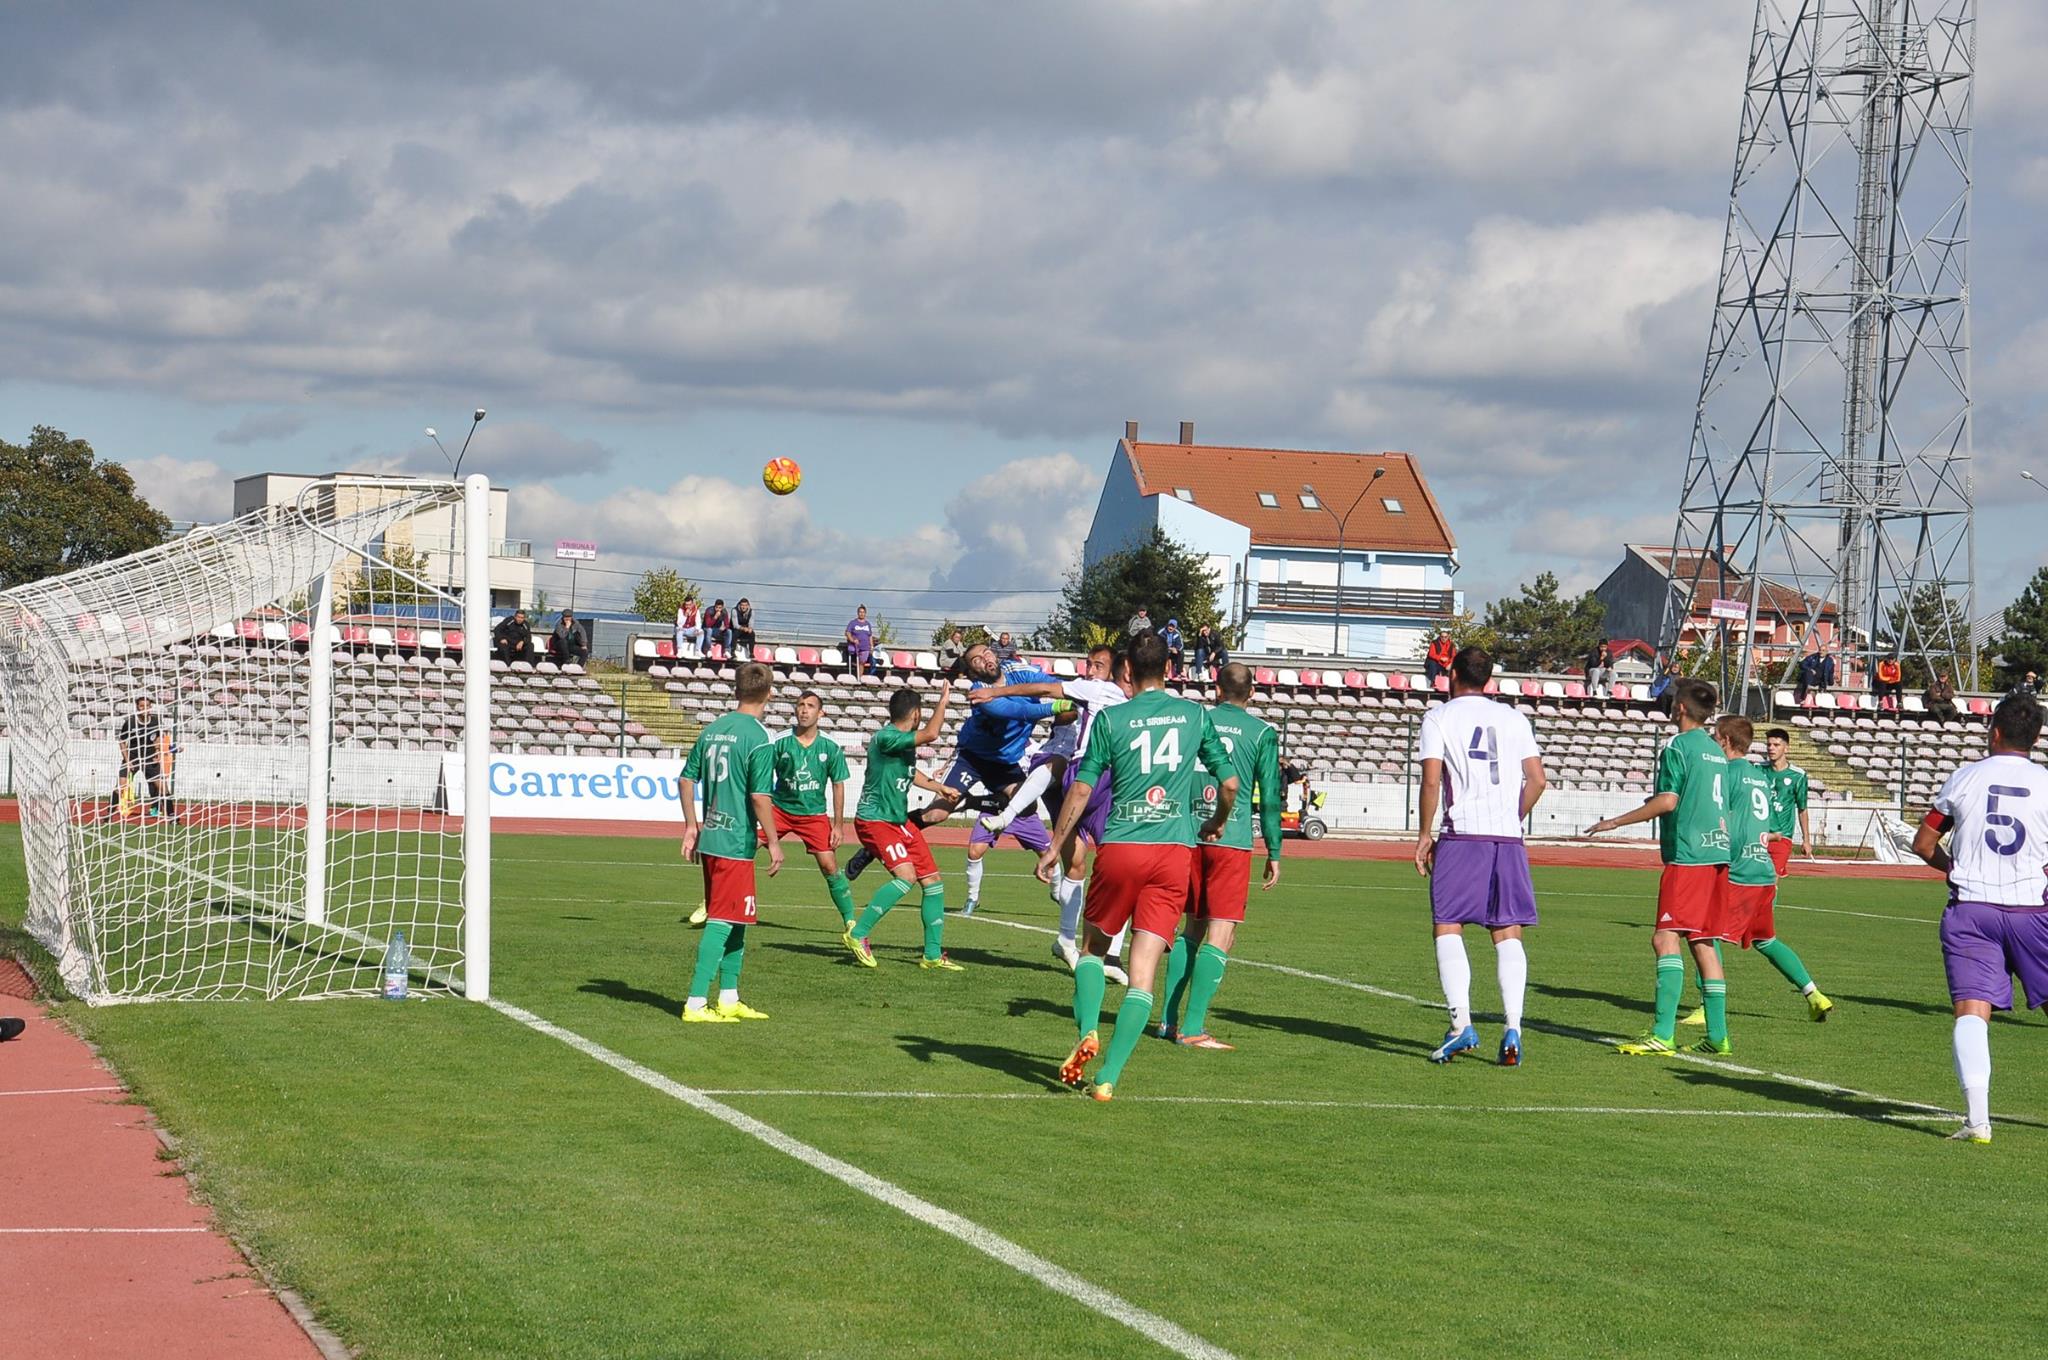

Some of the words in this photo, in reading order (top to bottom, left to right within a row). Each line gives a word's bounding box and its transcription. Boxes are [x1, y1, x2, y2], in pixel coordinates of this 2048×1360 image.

[705, 744, 730, 783] 15
[1129, 727, 1183, 774] 14
[1468, 726, 1500, 785] 4
[960, 771, 973, 787] 12
[1712, 773, 1724, 811] 4
[1752, 788, 1769, 820] 9
[1984, 784, 2031, 856] 5
[886, 842, 908, 862] 10
